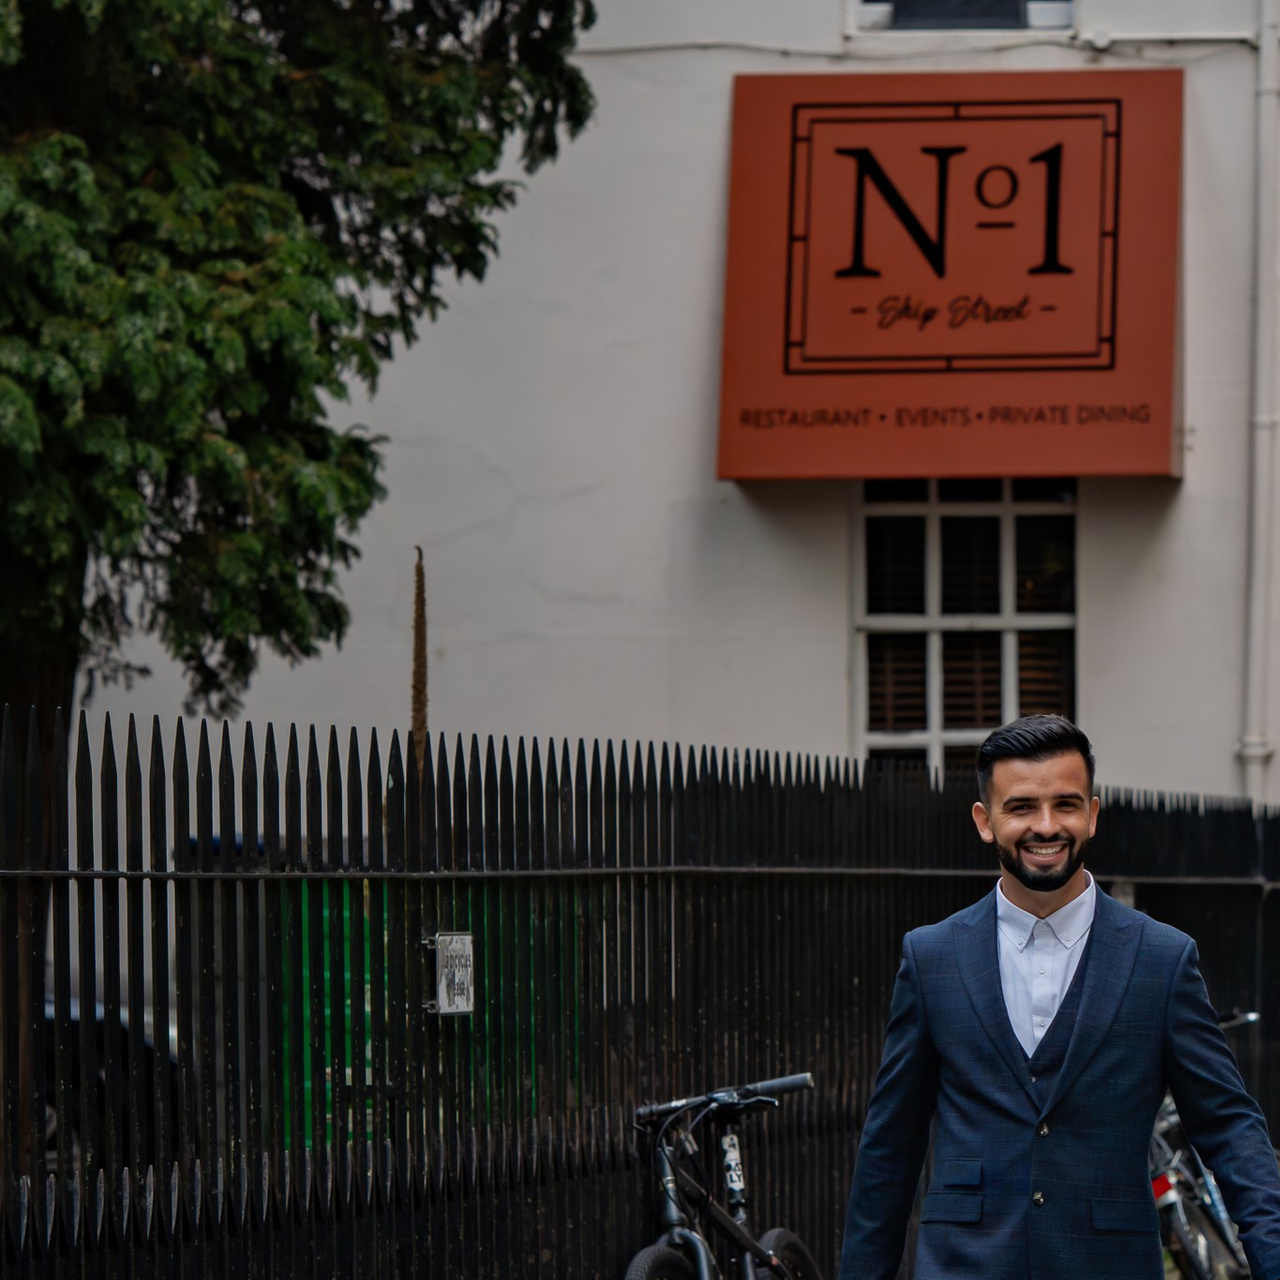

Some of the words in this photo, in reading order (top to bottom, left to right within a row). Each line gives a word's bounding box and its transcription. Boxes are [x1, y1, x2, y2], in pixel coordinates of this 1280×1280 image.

[876, 294, 940, 331] Ship
[947, 294, 1031, 329] Street
[739, 407, 870, 429] RESTAURANT
[894, 406, 972, 427] EVENTS
[988, 404, 1071, 426] PRIVATE
[1076, 403, 1151, 424] DINING
